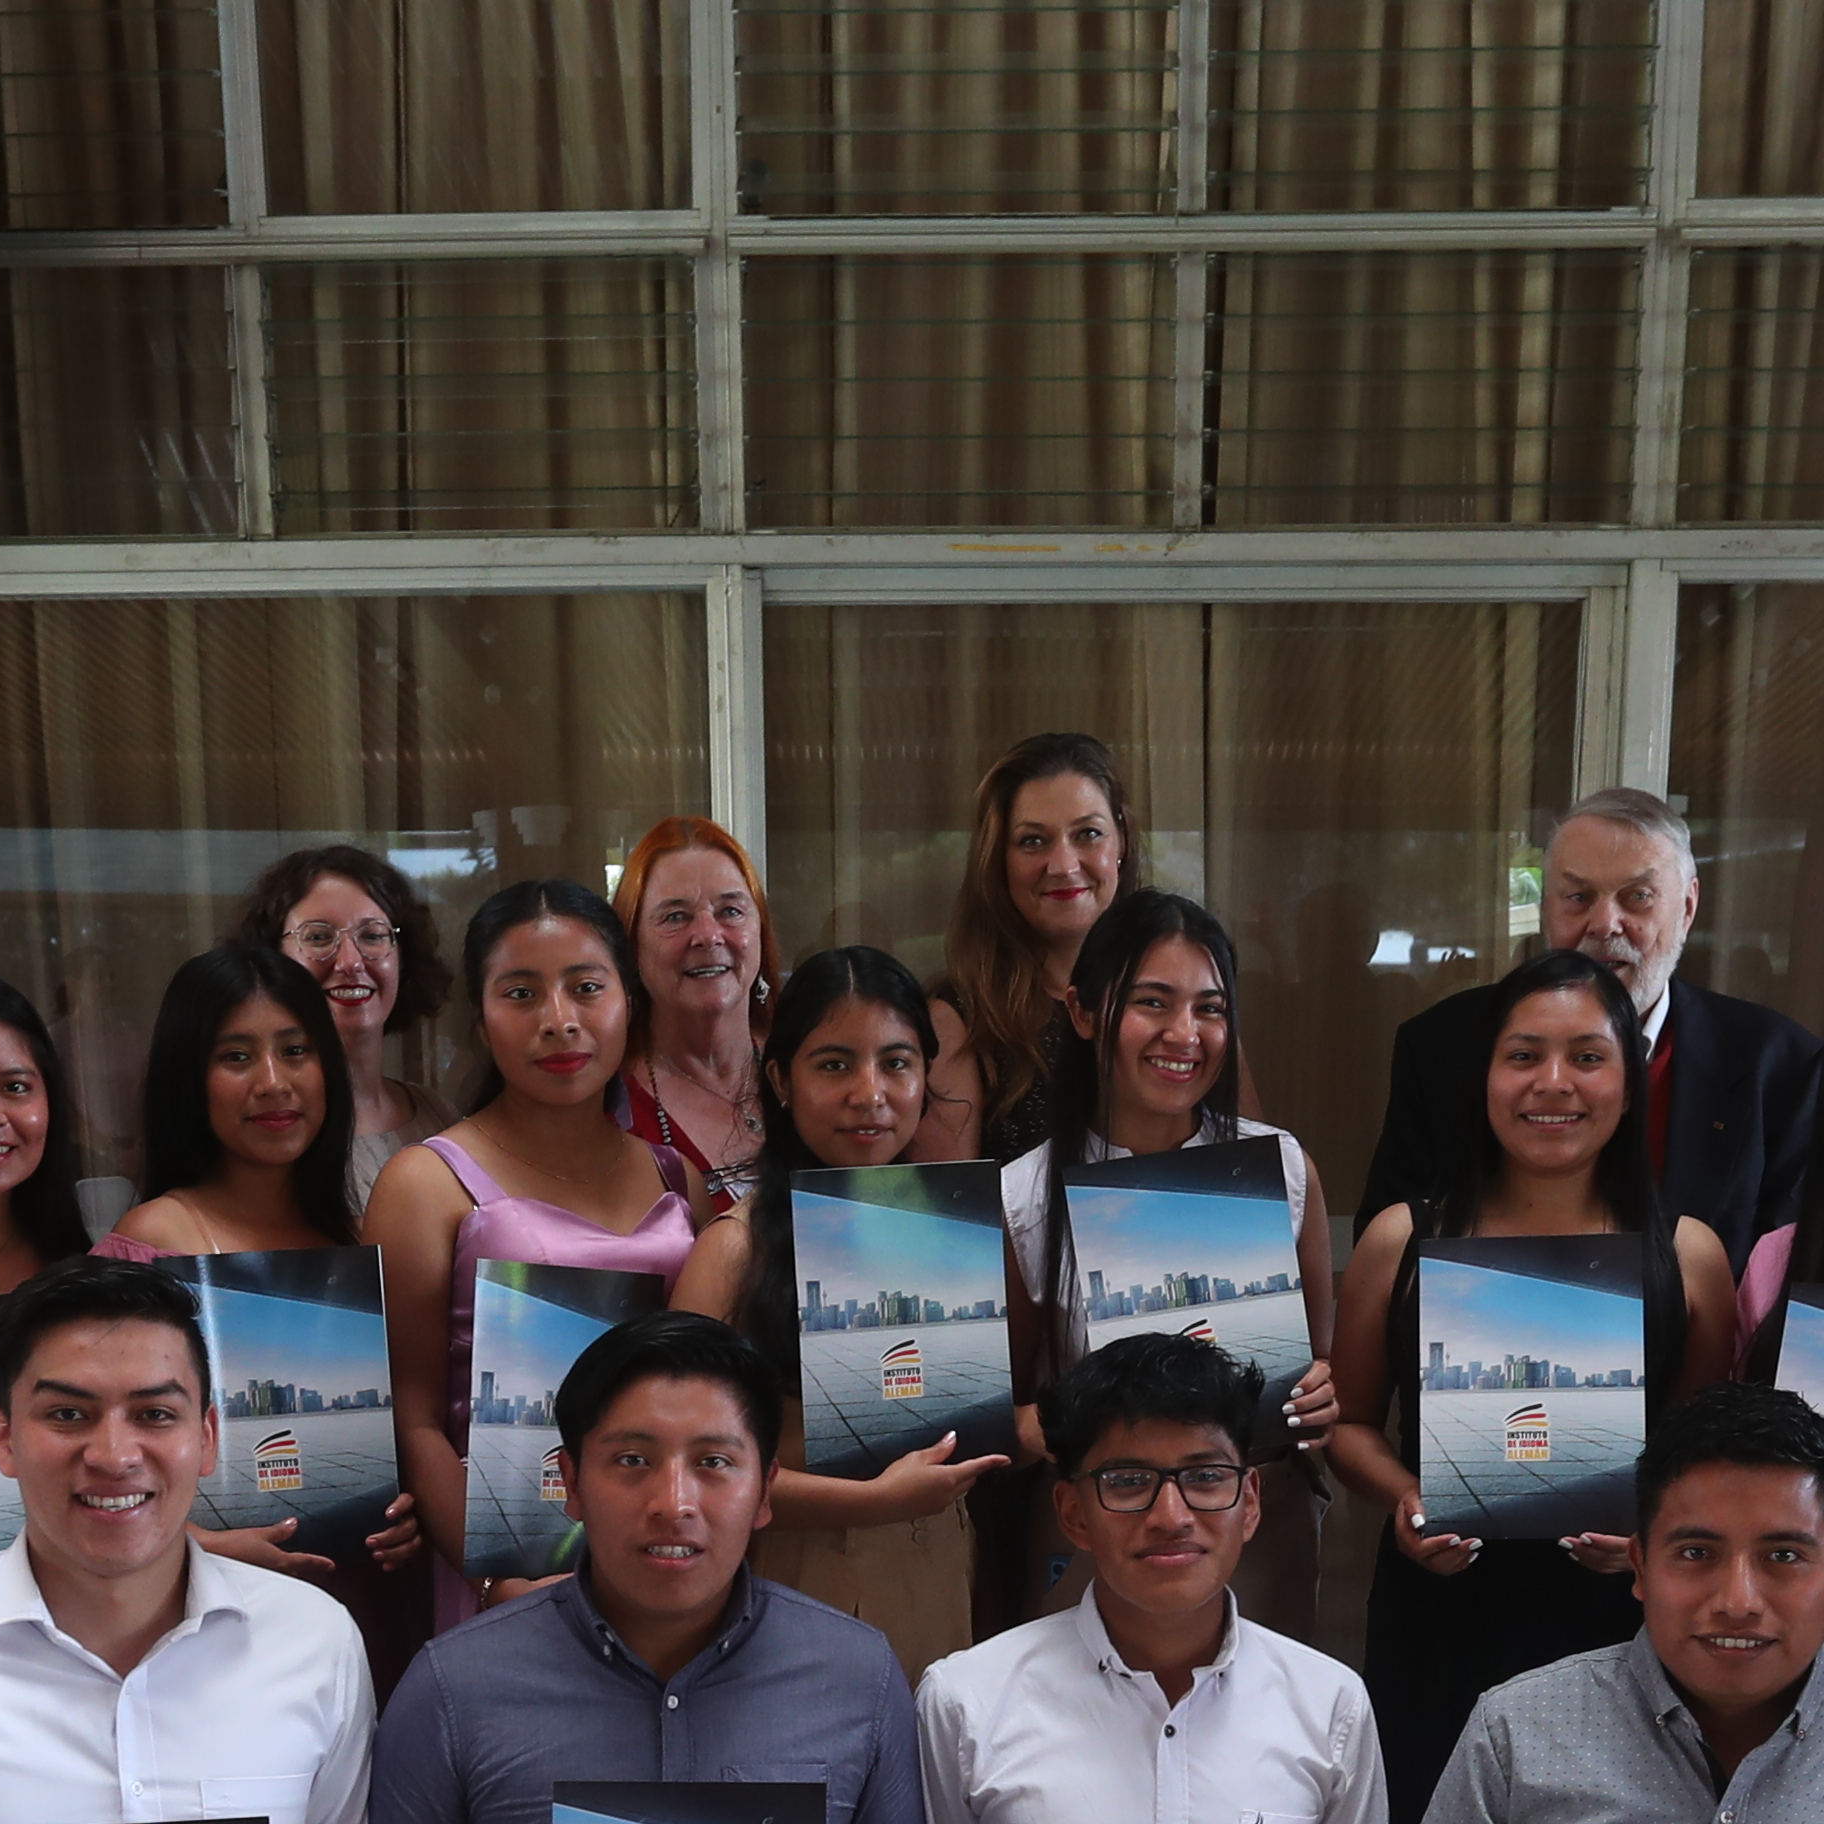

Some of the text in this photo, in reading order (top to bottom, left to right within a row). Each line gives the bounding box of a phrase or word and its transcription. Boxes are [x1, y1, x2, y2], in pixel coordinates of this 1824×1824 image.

[883, 1367, 920, 1378] INSTITUTO
[884, 1376, 922, 1386] DE IDIOMA
[1507, 1431, 1548, 1439] INSTITUTO
[1507, 1440, 1516, 1448] DE
[257, 1458, 299, 1469] INSTITUTO
[258, 1467, 301, 1478] DE IDIOMA
